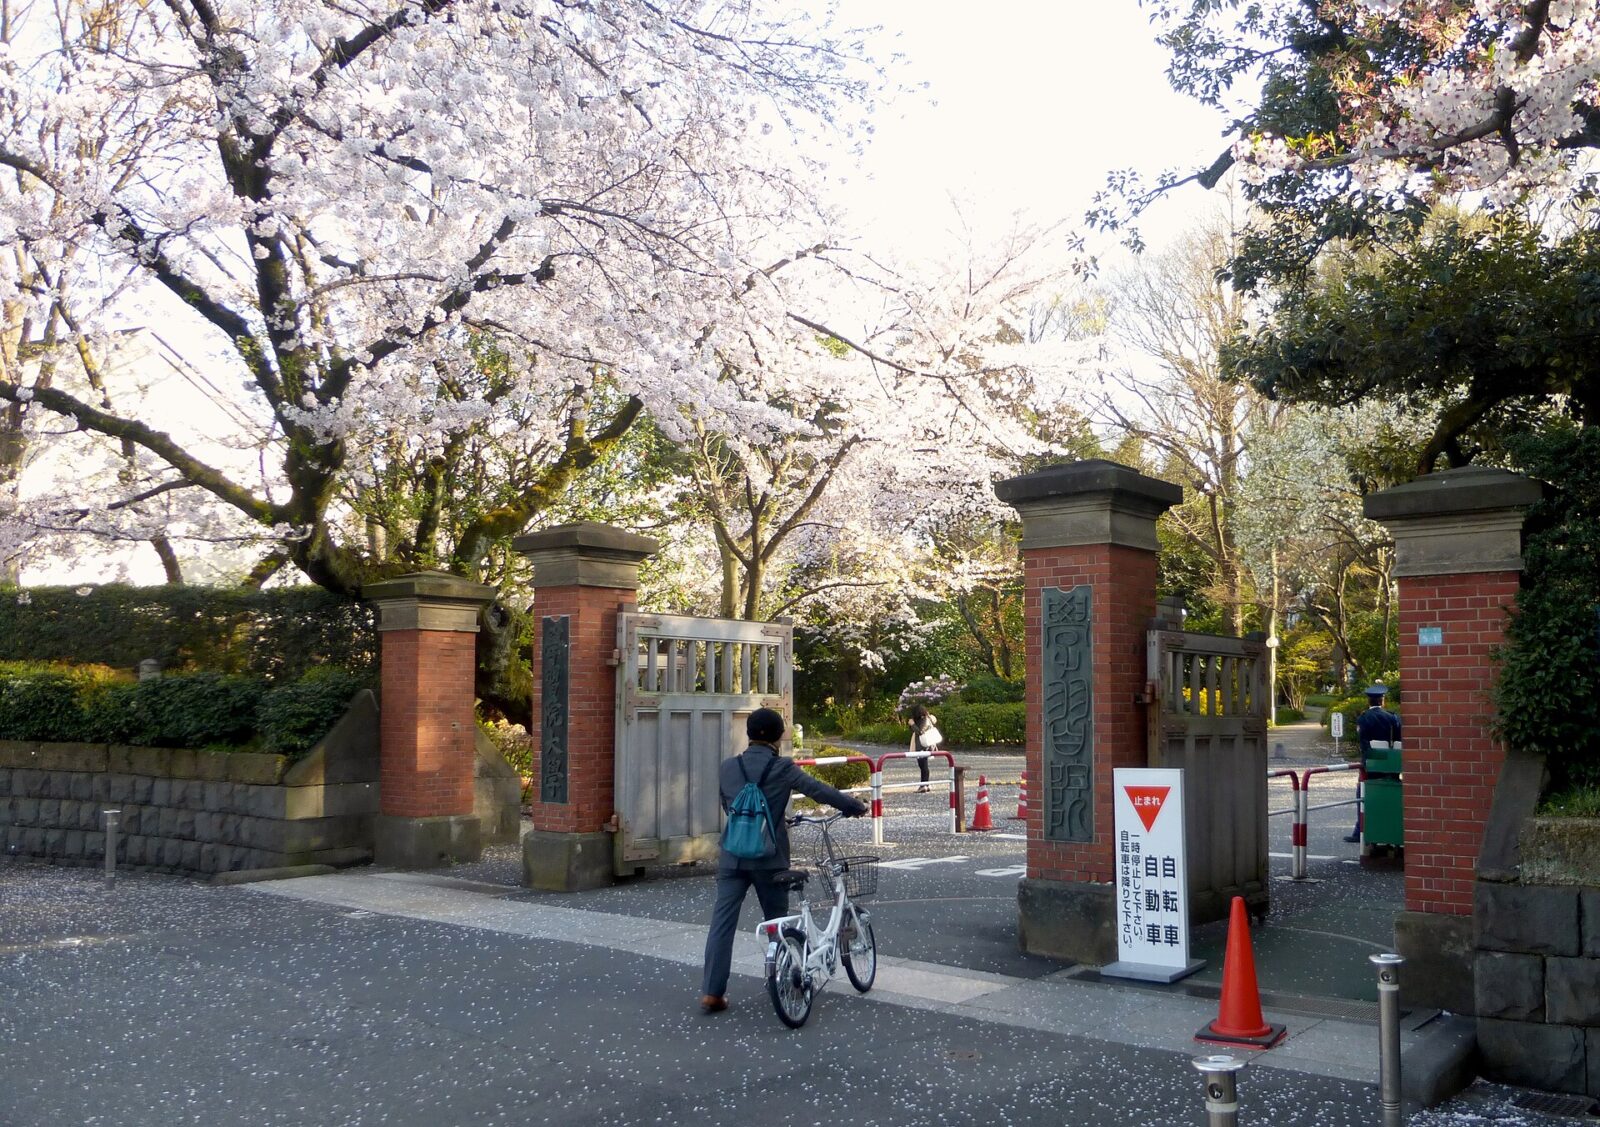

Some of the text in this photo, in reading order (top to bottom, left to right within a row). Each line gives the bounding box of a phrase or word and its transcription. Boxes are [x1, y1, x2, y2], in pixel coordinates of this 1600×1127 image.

[1134, 795, 1161, 806] 止まれ
[1120, 830, 1132, 948] 自転車は降りて下さい。
[1130, 834, 1143, 941] 一時停止して下さい。
[1144, 854, 1162, 946] 自動車
[1162, 855, 1180, 947] 自転車
